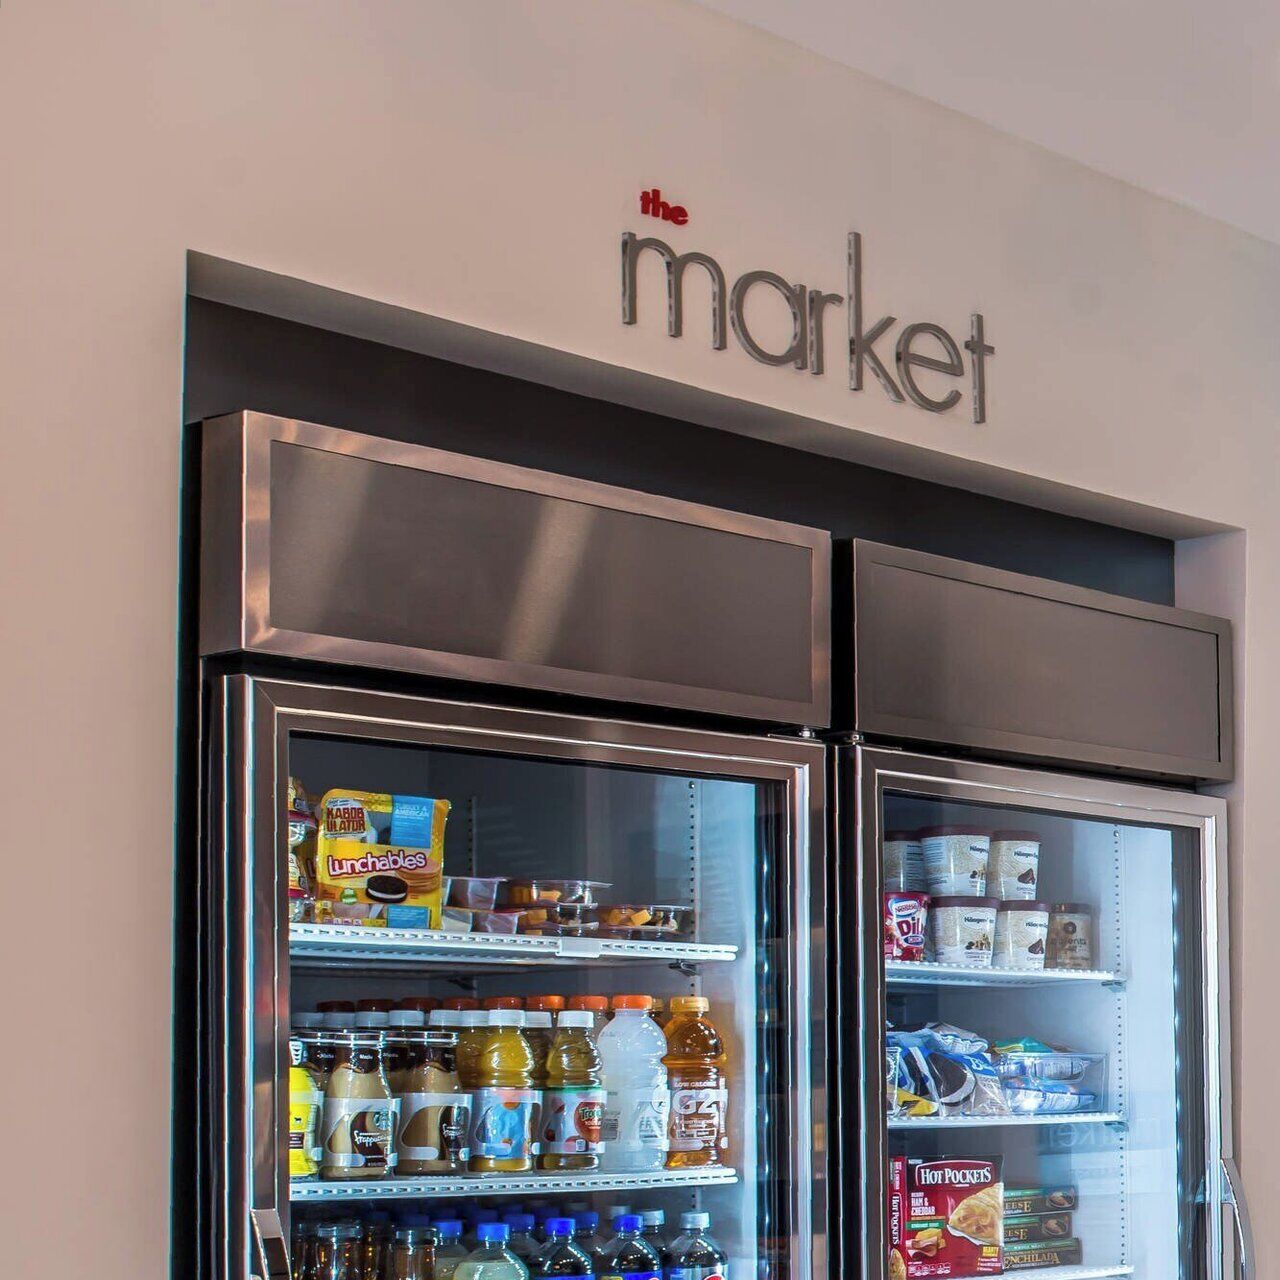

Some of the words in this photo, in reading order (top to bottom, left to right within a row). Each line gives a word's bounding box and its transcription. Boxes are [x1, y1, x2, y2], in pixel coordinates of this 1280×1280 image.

[640, 189, 688, 226] the
[621, 232, 995, 424] market
[327, 850, 427, 877] Lunchables
[673, 1089, 716, 1114] G2
[920, 1168, 943, 1185] HOT
[944, 1167, 992, 1184] POCKETS
[891, 1210, 900, 1245] POCKETS
